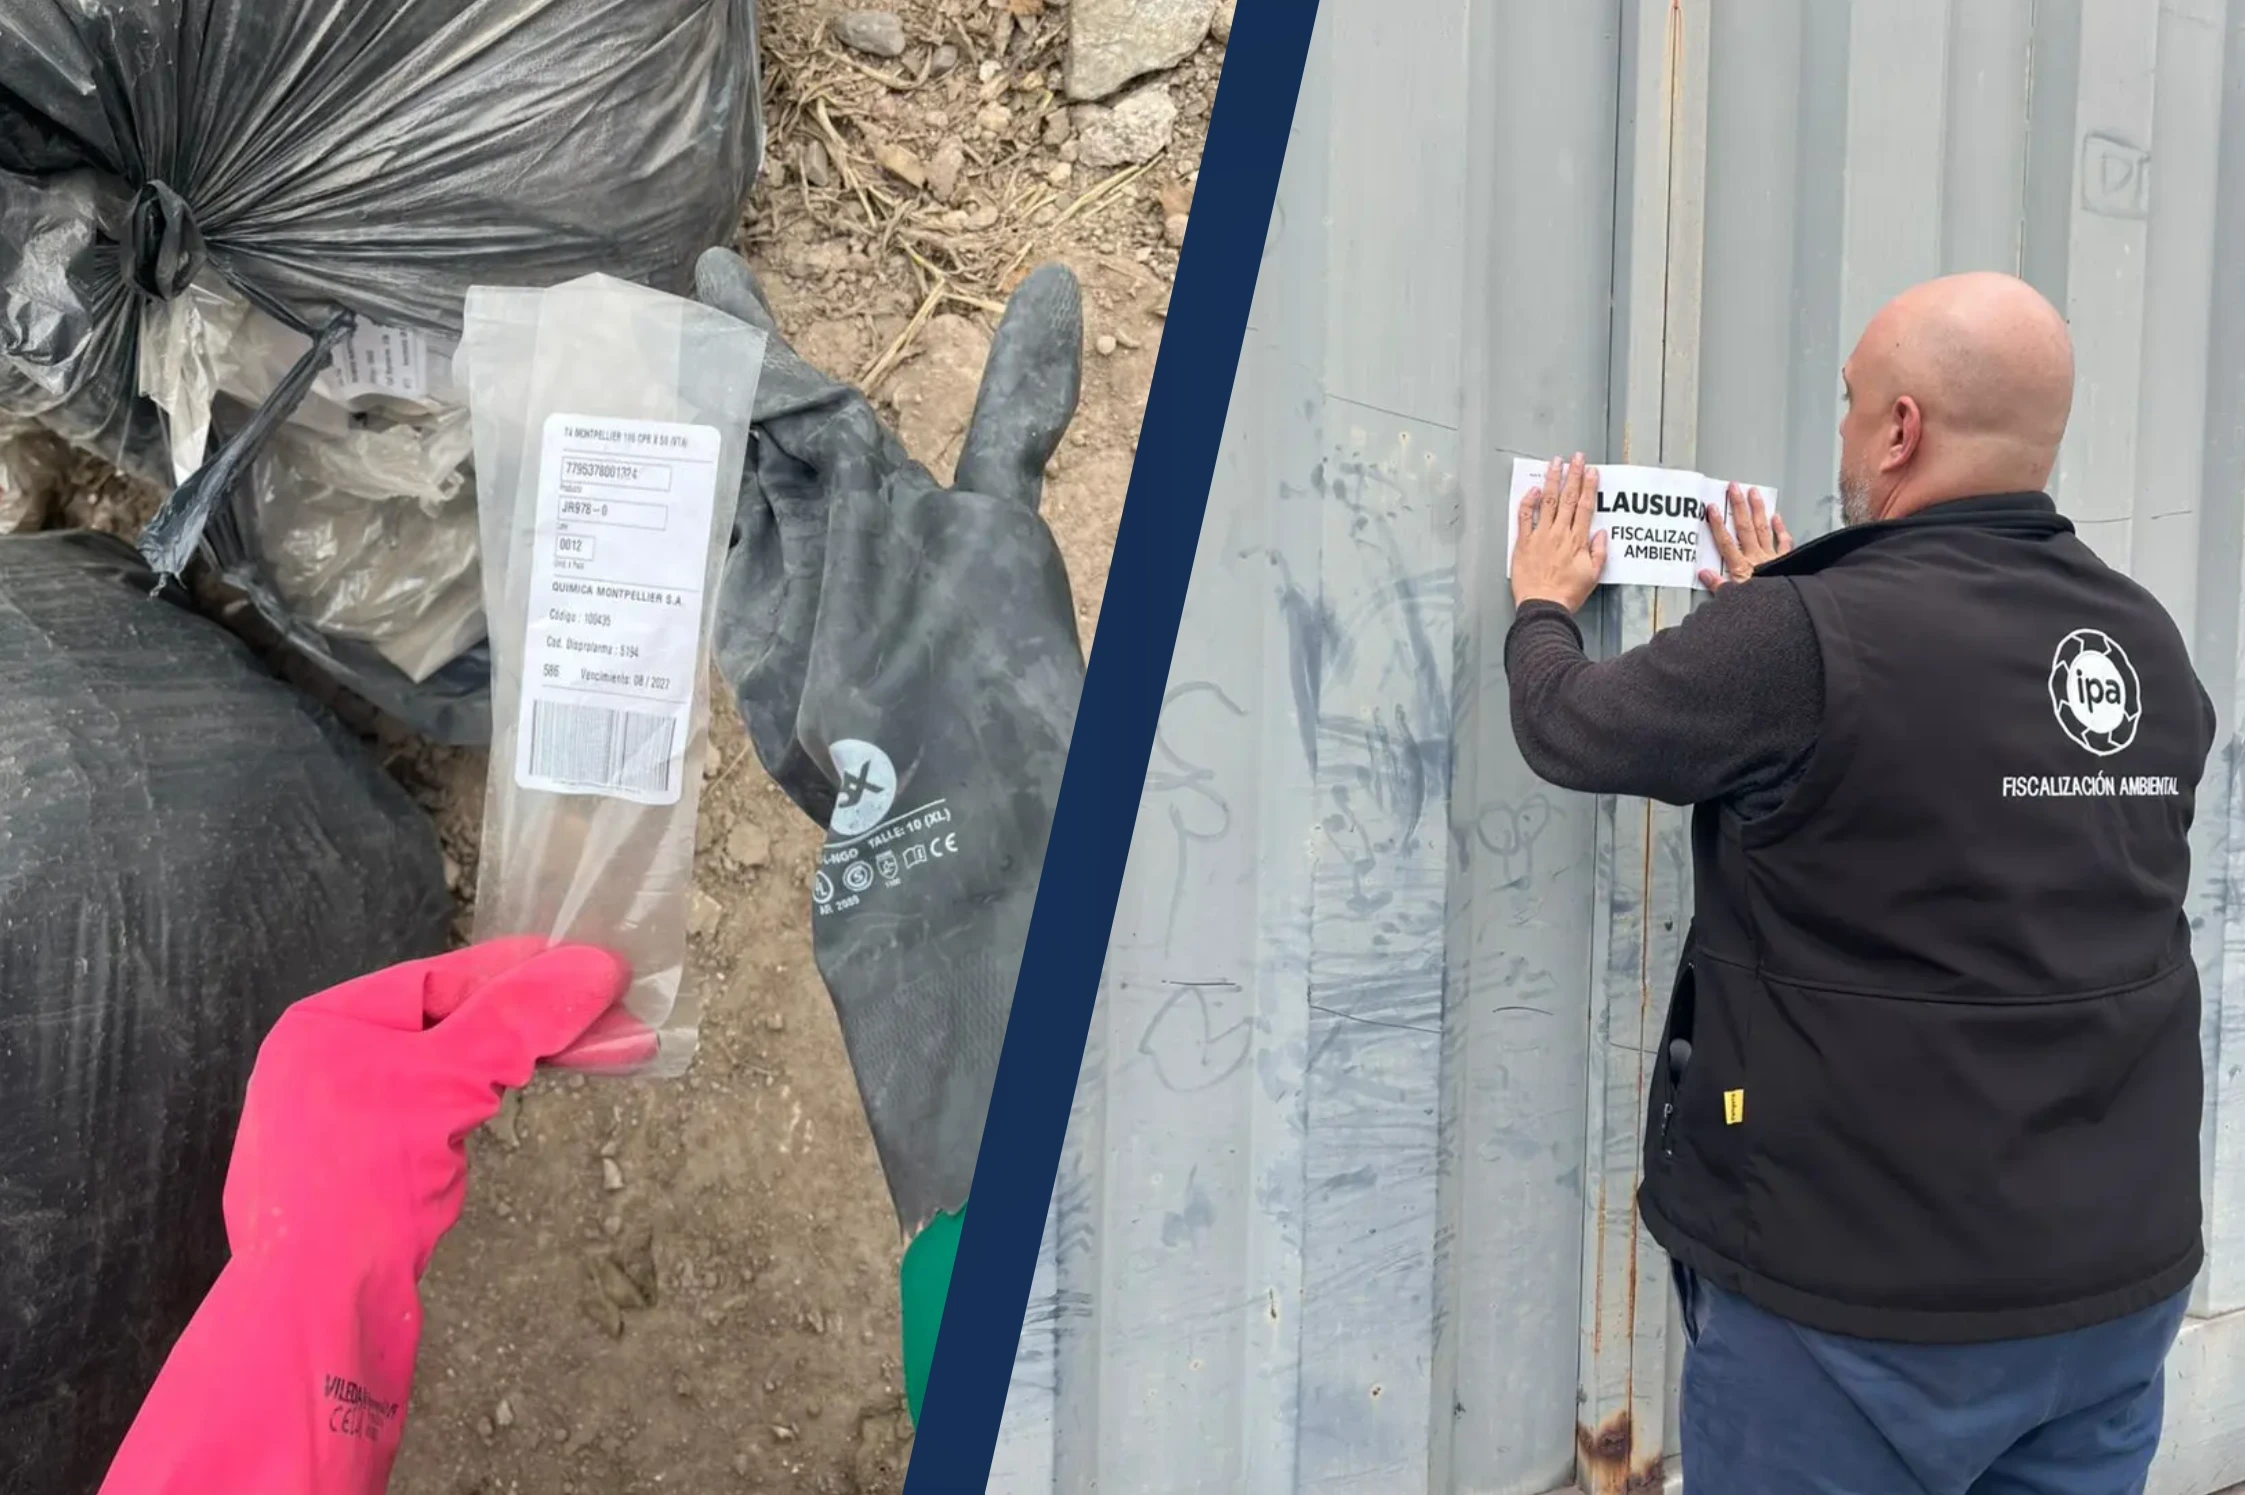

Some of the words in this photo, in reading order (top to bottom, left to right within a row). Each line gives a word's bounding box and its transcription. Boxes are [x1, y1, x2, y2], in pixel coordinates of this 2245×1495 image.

[574, 427, 622, 442] MONTPELLIER
[1596, 490, 1709, 523] LAUSUR
[559, 538, 583, 552] 0012
[551, 582, 593, 595] QUIMICA
[596, 587, 663, 603] MONTPELLIER
[2076, 669, 2122, 714] ipa
[2002, 770, 2116, 798] FISCALIZACIÓN
[2119, 776, 2180, 796] AMBIENTAL
[867, 826, 906, 849] TALLE:
[906, 820, 922, 834] 10
[924, 808, 951, 828] (XL)
